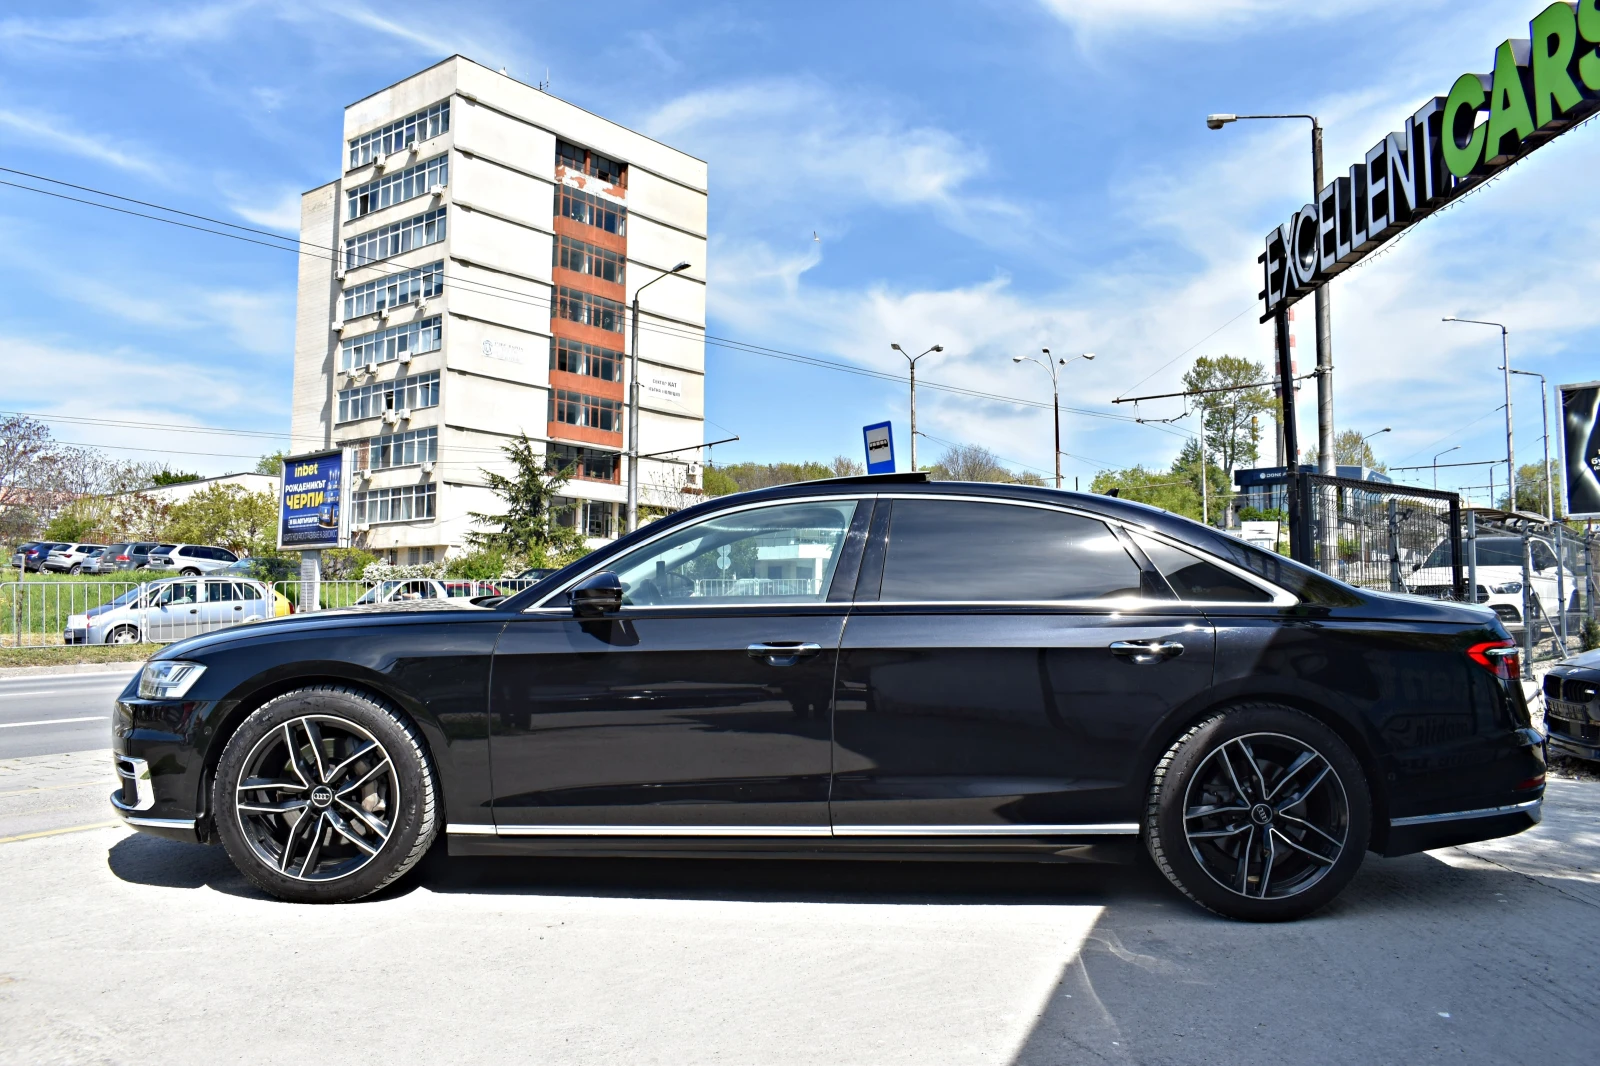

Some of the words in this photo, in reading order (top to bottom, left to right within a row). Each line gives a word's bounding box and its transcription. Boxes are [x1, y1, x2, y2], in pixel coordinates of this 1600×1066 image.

[1265, 96, 1447, 312] EXCELLENT
[294, 462, 318, 477] inbet
[285, 480, 326, 492] РОЖДЕНИКЪТ
[286, 491, 324, 509] ЧЕРПИ
